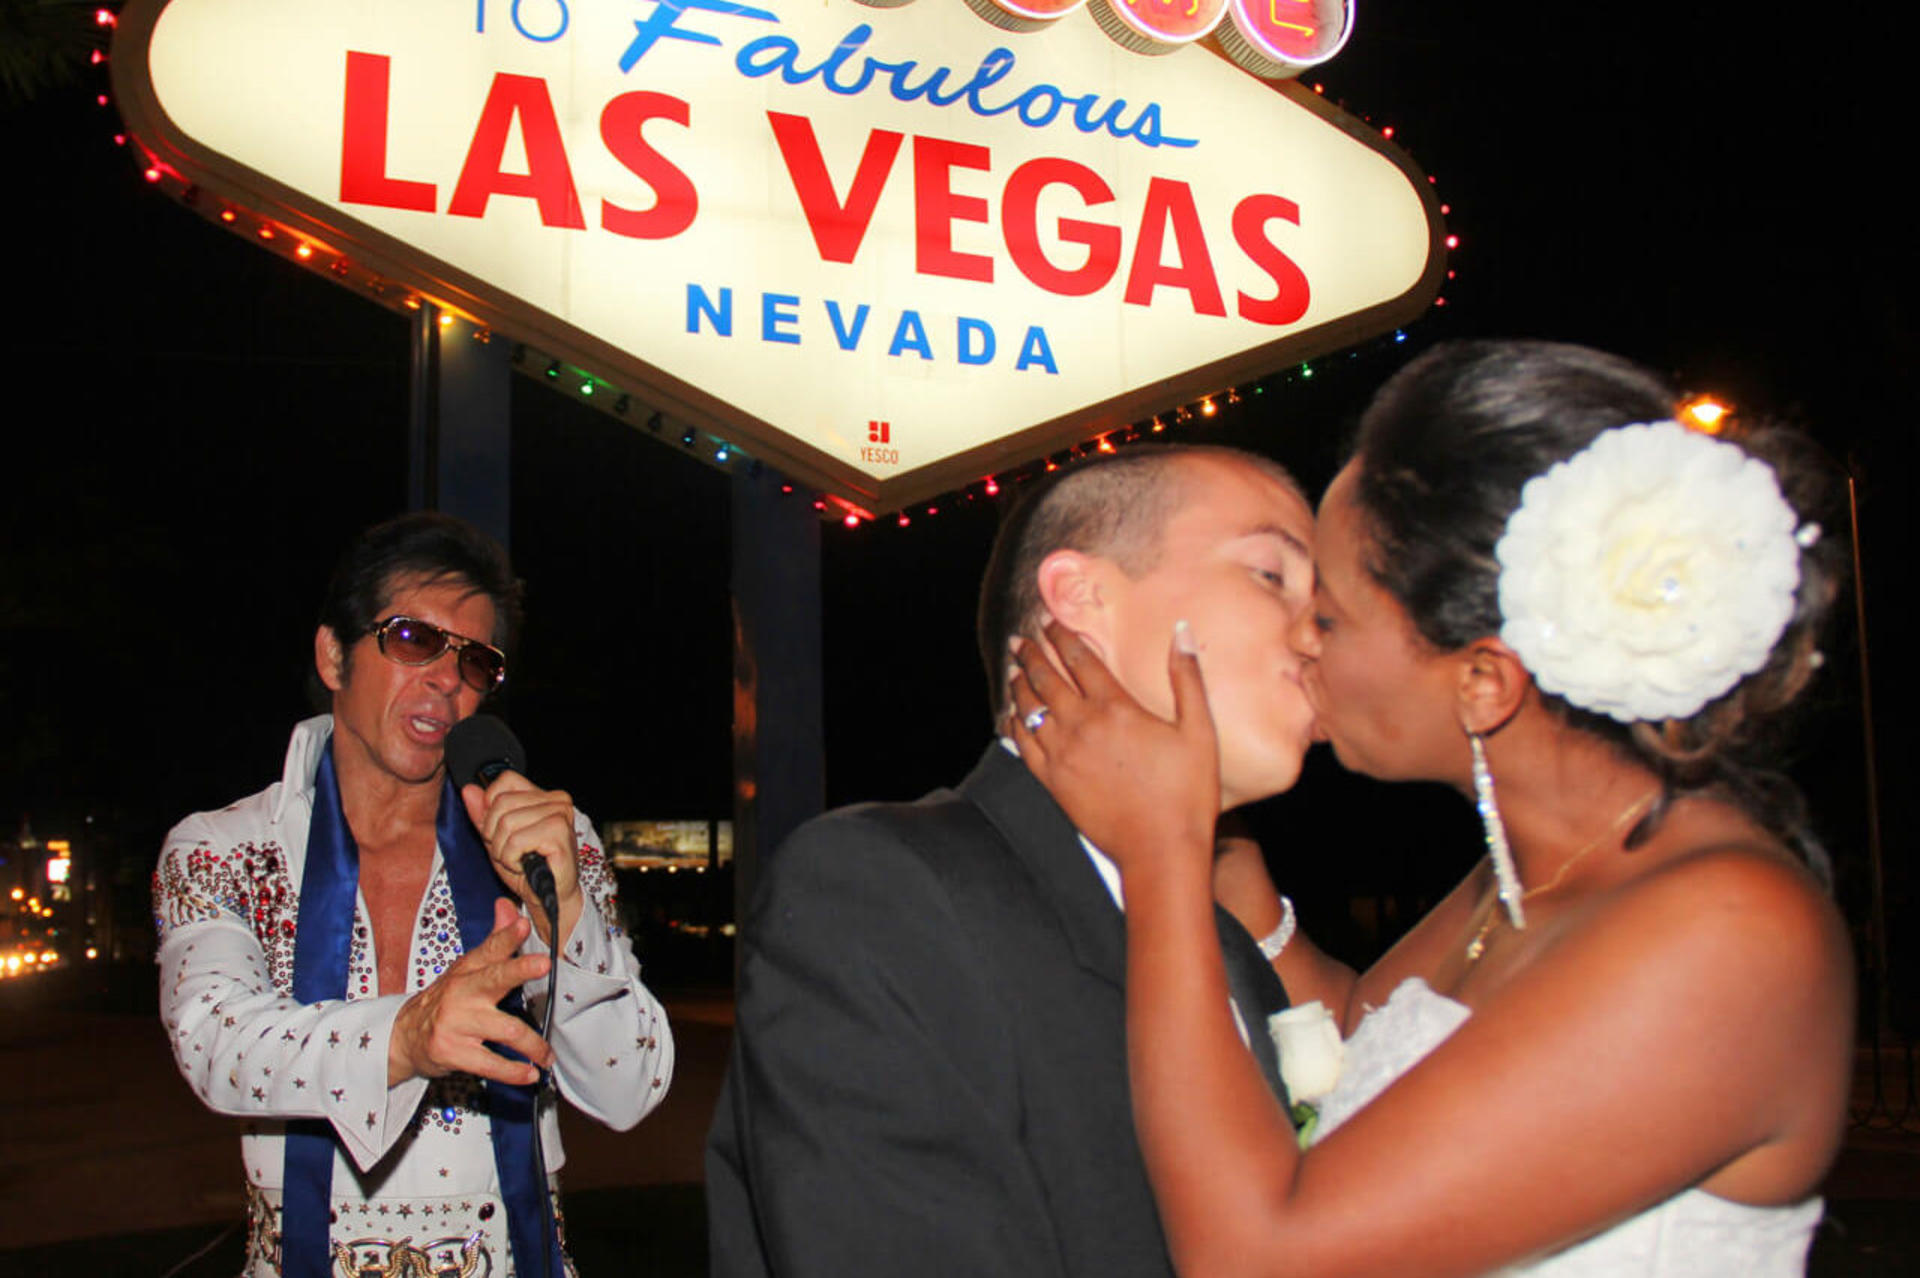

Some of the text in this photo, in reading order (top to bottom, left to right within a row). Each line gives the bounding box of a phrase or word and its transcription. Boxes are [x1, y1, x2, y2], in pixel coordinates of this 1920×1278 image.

[618, 0, 1199, 148] Fabulous
[340, 50, 1311, 326] LAS VEGAS
[686, 283, 1060, 375] NEVADA
[860, 447, 899, 465] YESCO
